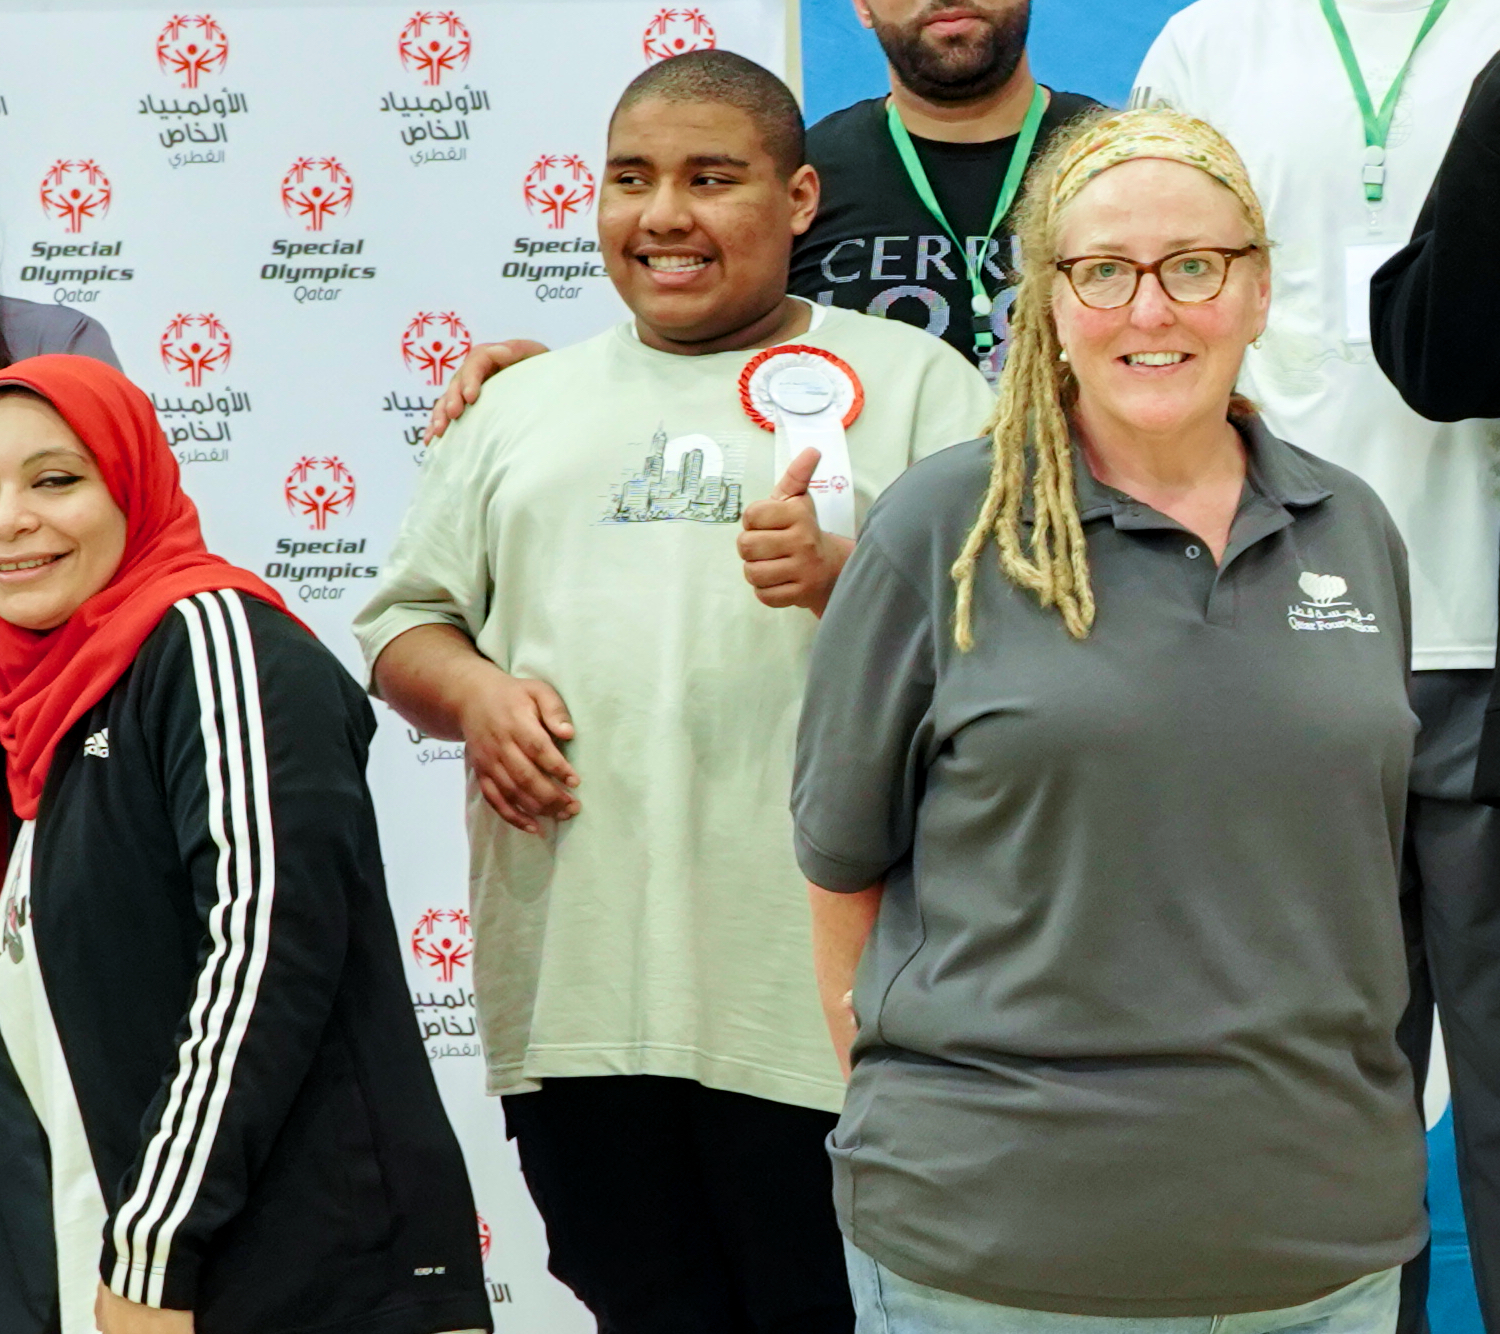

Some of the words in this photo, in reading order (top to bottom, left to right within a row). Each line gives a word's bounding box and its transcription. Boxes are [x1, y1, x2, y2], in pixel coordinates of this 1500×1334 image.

[139, 87, 248, 120] الأولمبياد
[380, 85, 490, 117] الأولمبياد
[159, 122, 228, 148] الخاص
[401, 119, 469, 146] الخاص
[31, 241, 122, 261] Special
[272, 239, 364, 259] Special
[20, 265, 134, 285] Olympics
[260, 264, 376, 283] Olympics
[53, 287, 101, 306] Qatar
[293, 285, 342, 305] Qatar
[535, 283, 583, 303] Qatar
[150, 386, 251, 418] الأولمبيا
[167, 421, 231, 447] الخاص
[276, 538, 366, 558] Special
[265, 563, 378, 582] Olympics
[298, 584, 346, 603] Qatar
